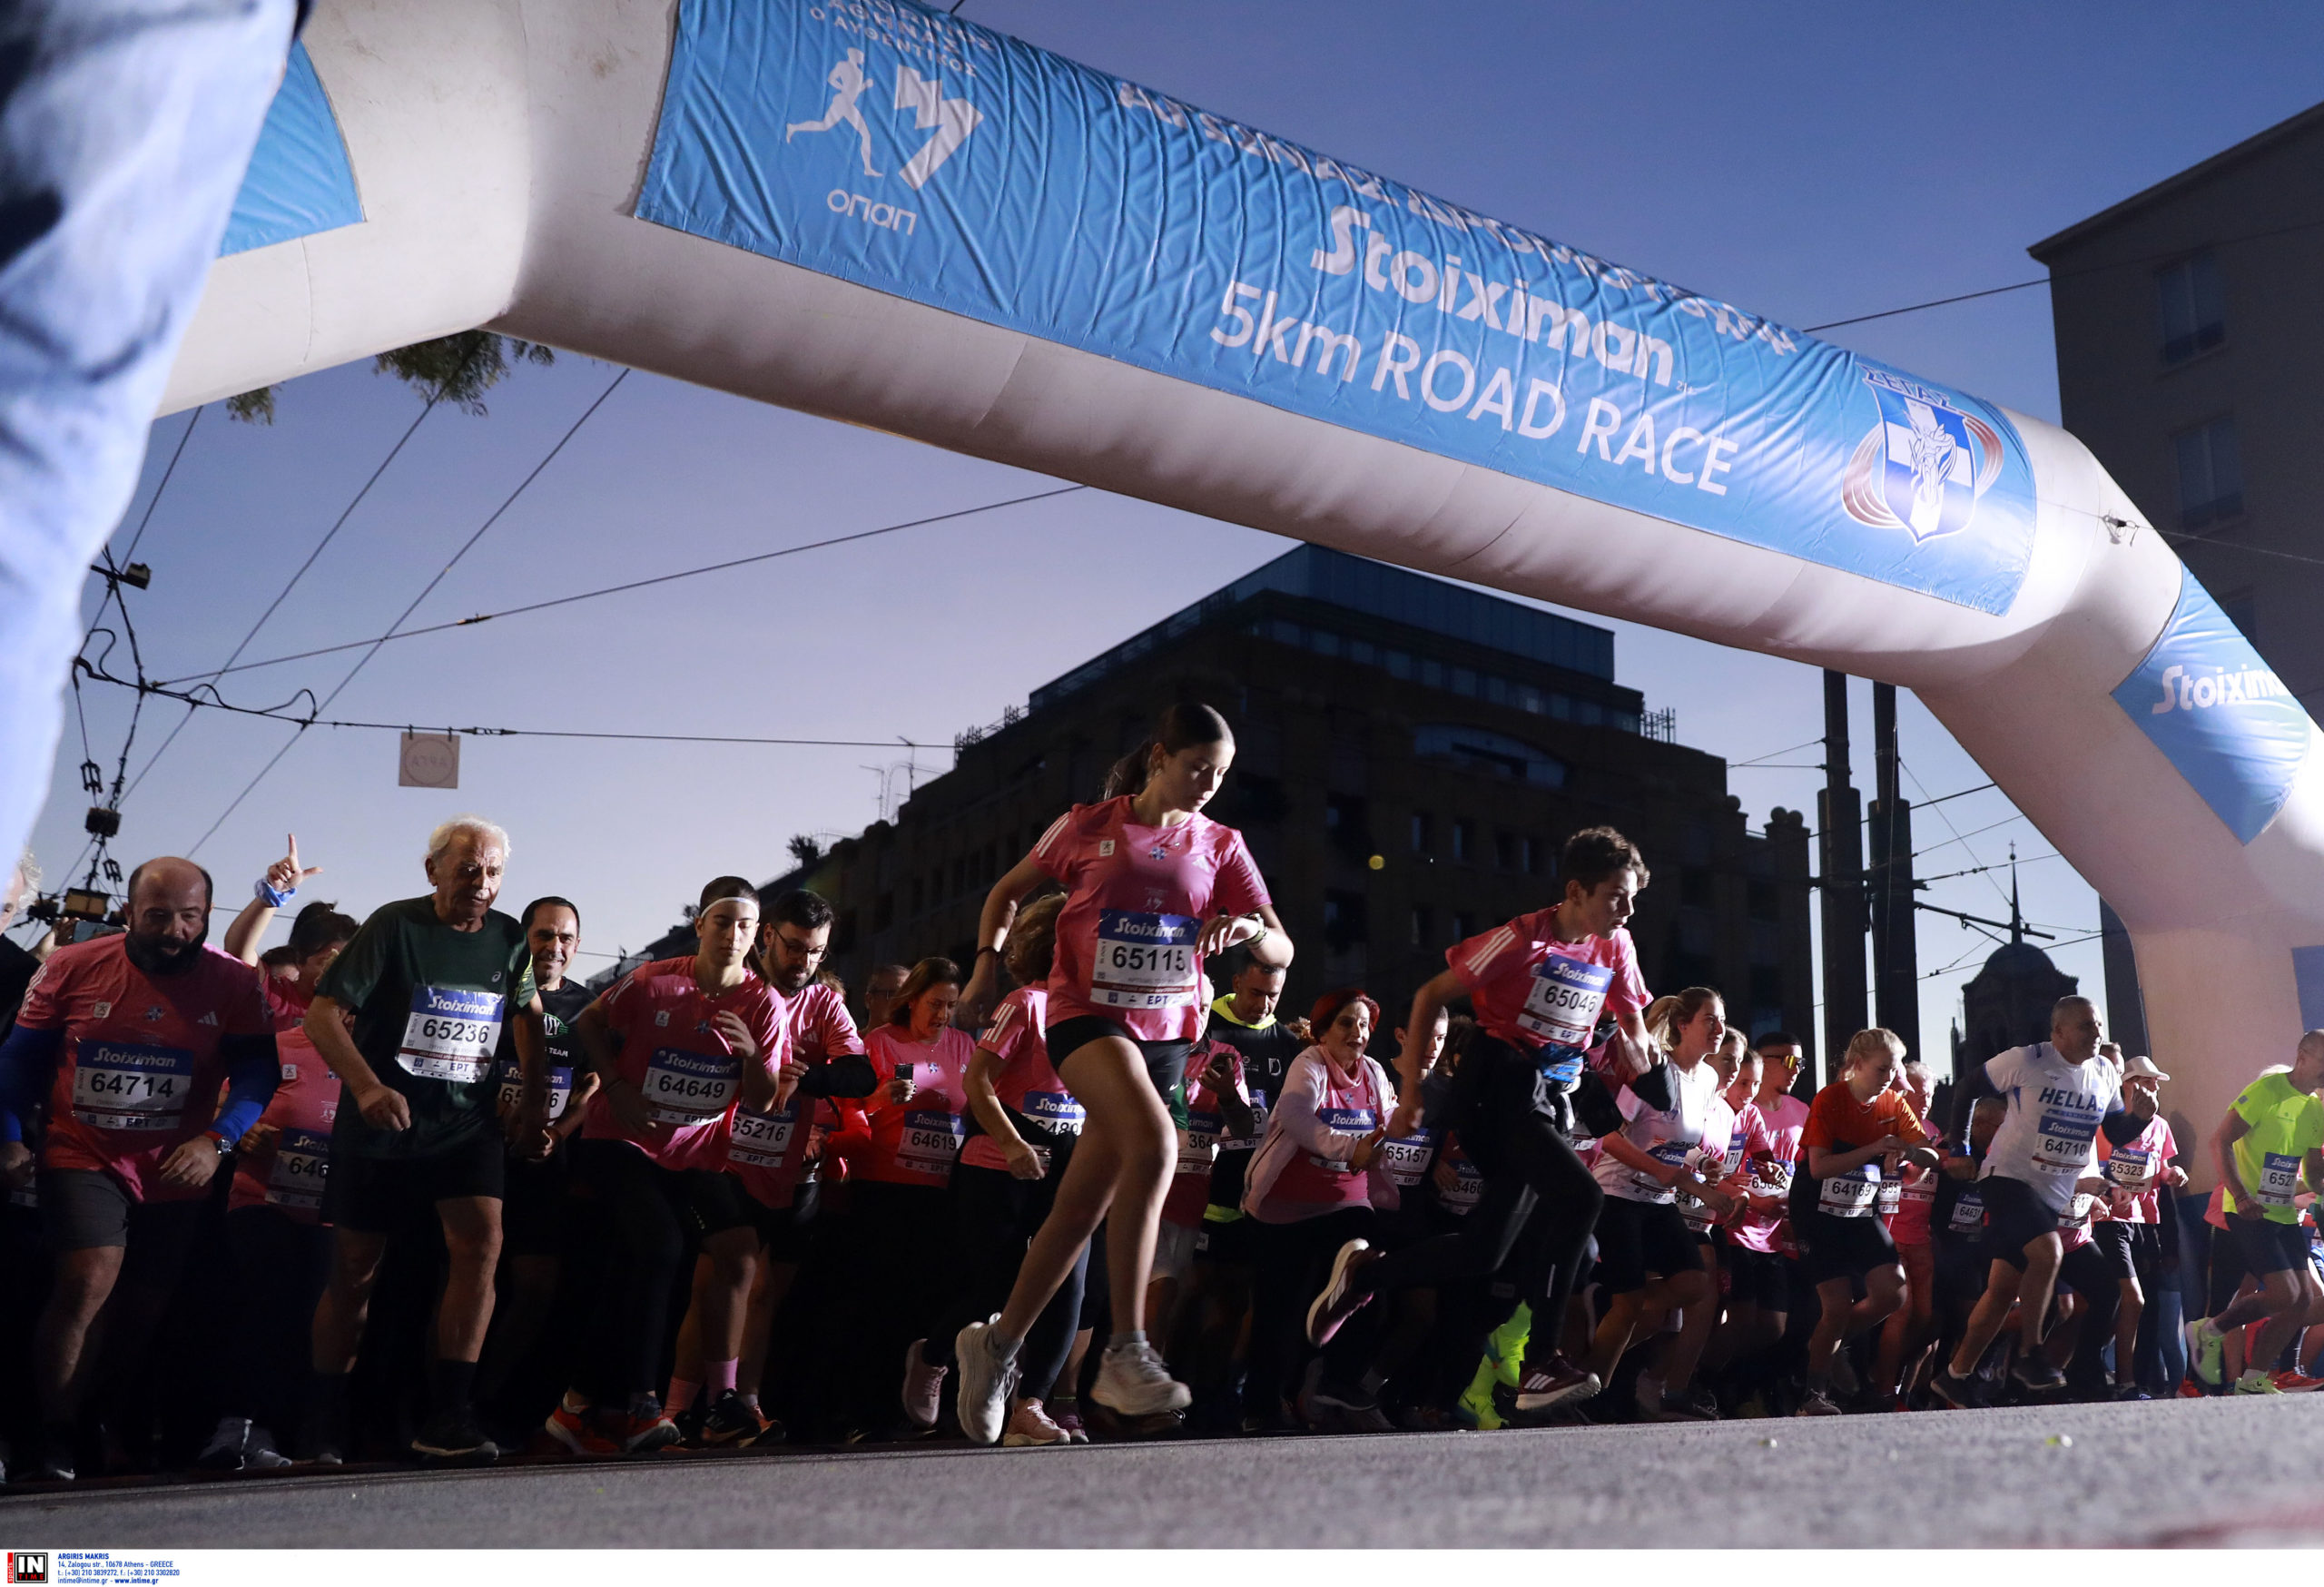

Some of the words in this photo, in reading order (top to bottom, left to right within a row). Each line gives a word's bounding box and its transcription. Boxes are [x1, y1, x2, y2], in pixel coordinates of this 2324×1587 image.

[1311, 205, 1673, 387] Stoiximan
[1210, 281, 1361, 382] 5km
[1371, 330, 1565, 439] ROAD
[1576, 398, 1738, 495] RACE
[1114, 917, 1186, 937] Stoiximan
[1112, 945, 1186, 971] 65115
[1553, 962, 1606, 986] Stoiximan
[428, 995, 496, 1015] Stoiximan
[423, 1019, 490, 1044] 65236
[94, 1048, 177, 1067] Stoiximan
[665, 1053, 731, 1074] Stoiximan
[92, 1072, 173, 1098] 64714
[658, 1074, 726, 1099] 64649
[2038, 1087, 2105, 1112] HELLAS
[911, 1131, 957, 1151] 64619
[1189, 1134, 1213, 1148] 364
[2045, 1138, 2087, 1157] 64710
[1386, 1146, 1427, 1163] 65157
[2110, 1161, 2143, 1177] 65323
[1832, 1181, 1872, 1197] 64169
